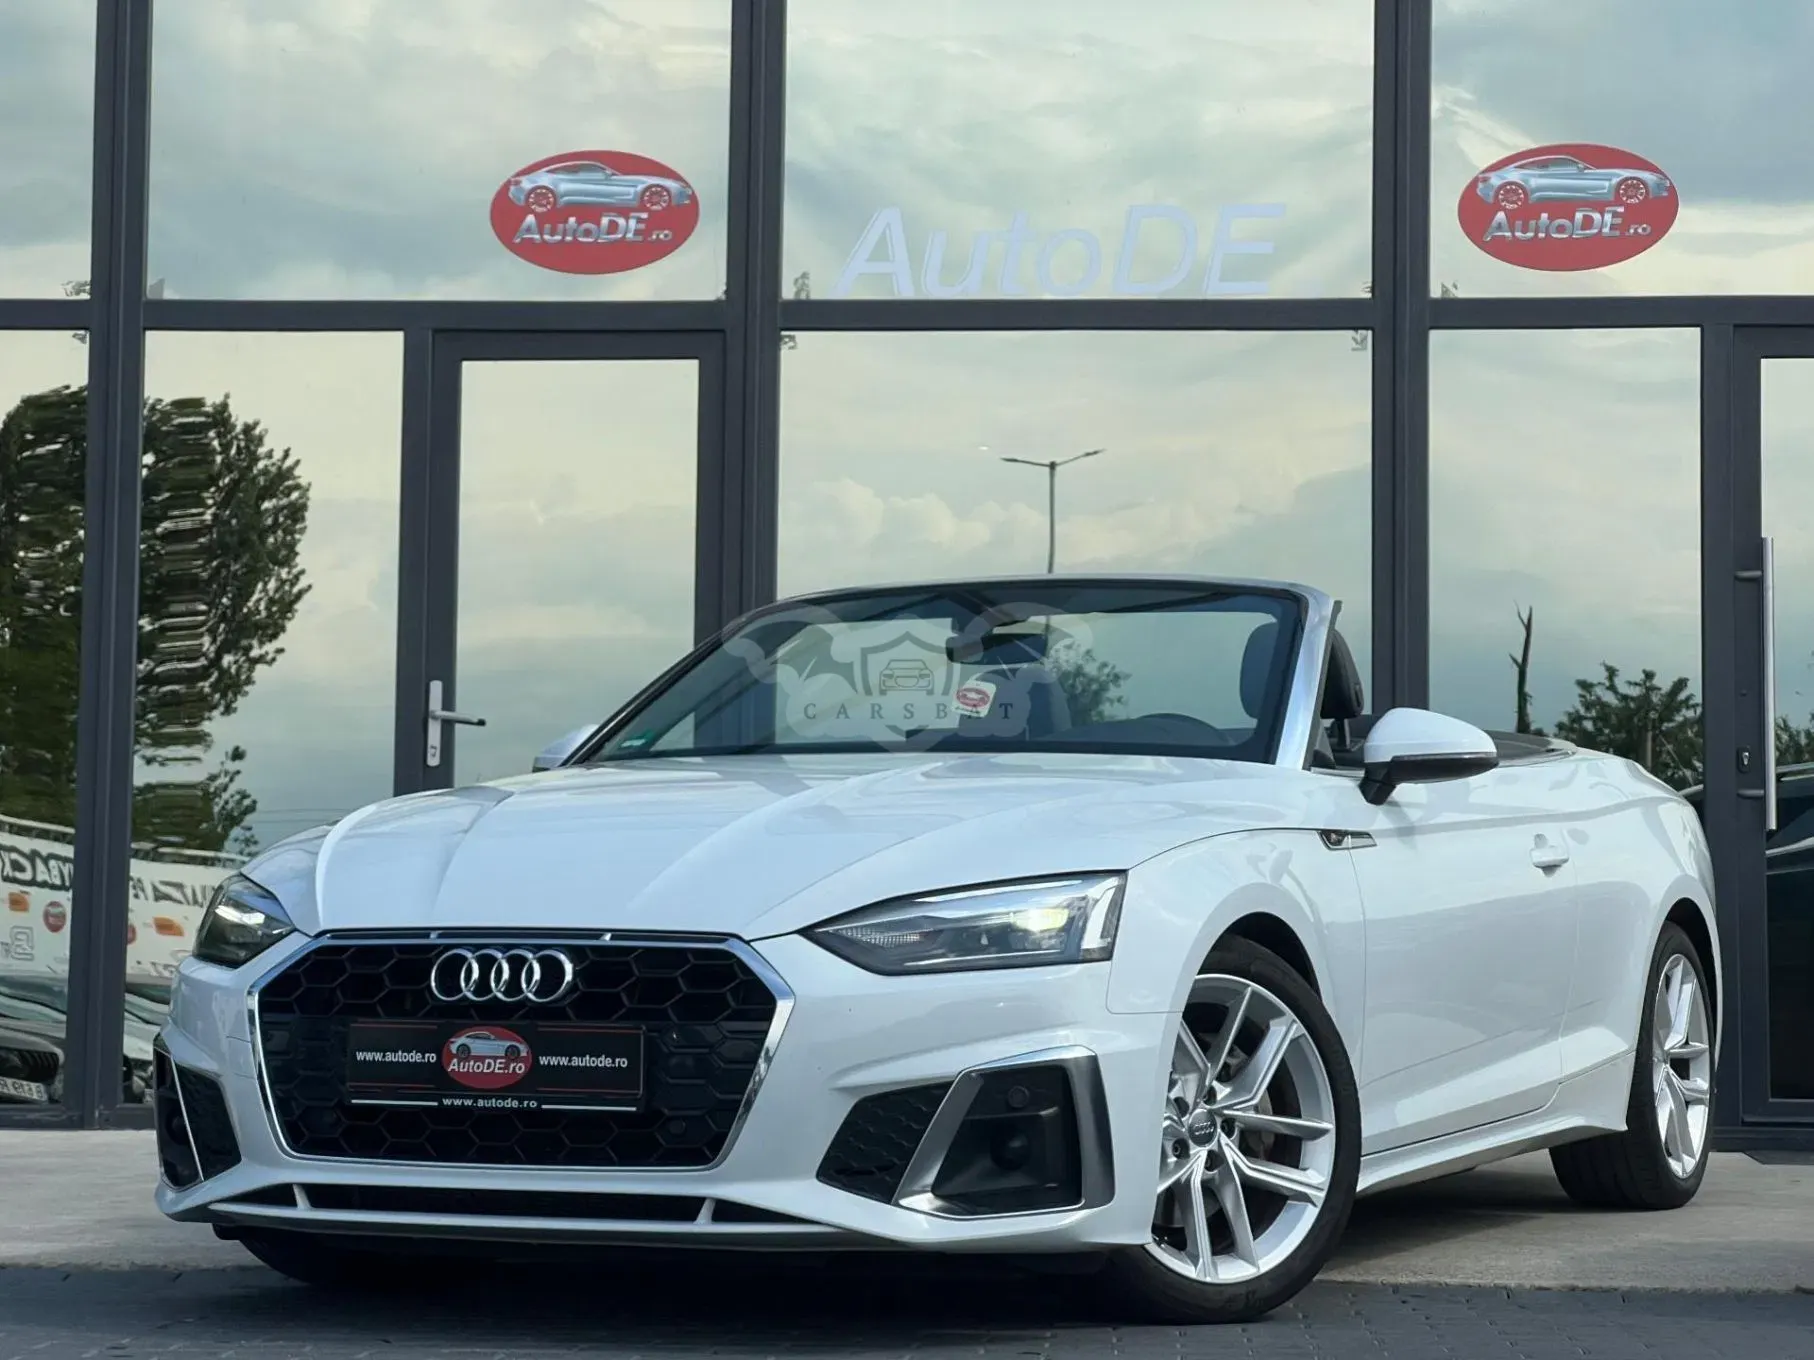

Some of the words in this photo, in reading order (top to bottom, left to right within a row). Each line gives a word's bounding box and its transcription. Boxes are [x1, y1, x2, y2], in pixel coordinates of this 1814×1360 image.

[826, 203, 1287, 298] AutoDE
[355, 1050, 437, 1063] www.autode.ro
[538, 1054, 629, 1068] www.autode.ro
[448, 1058, 526, 1074] AutoDE.ro
[442, 1097, 538, 1109] www.autode.ro
